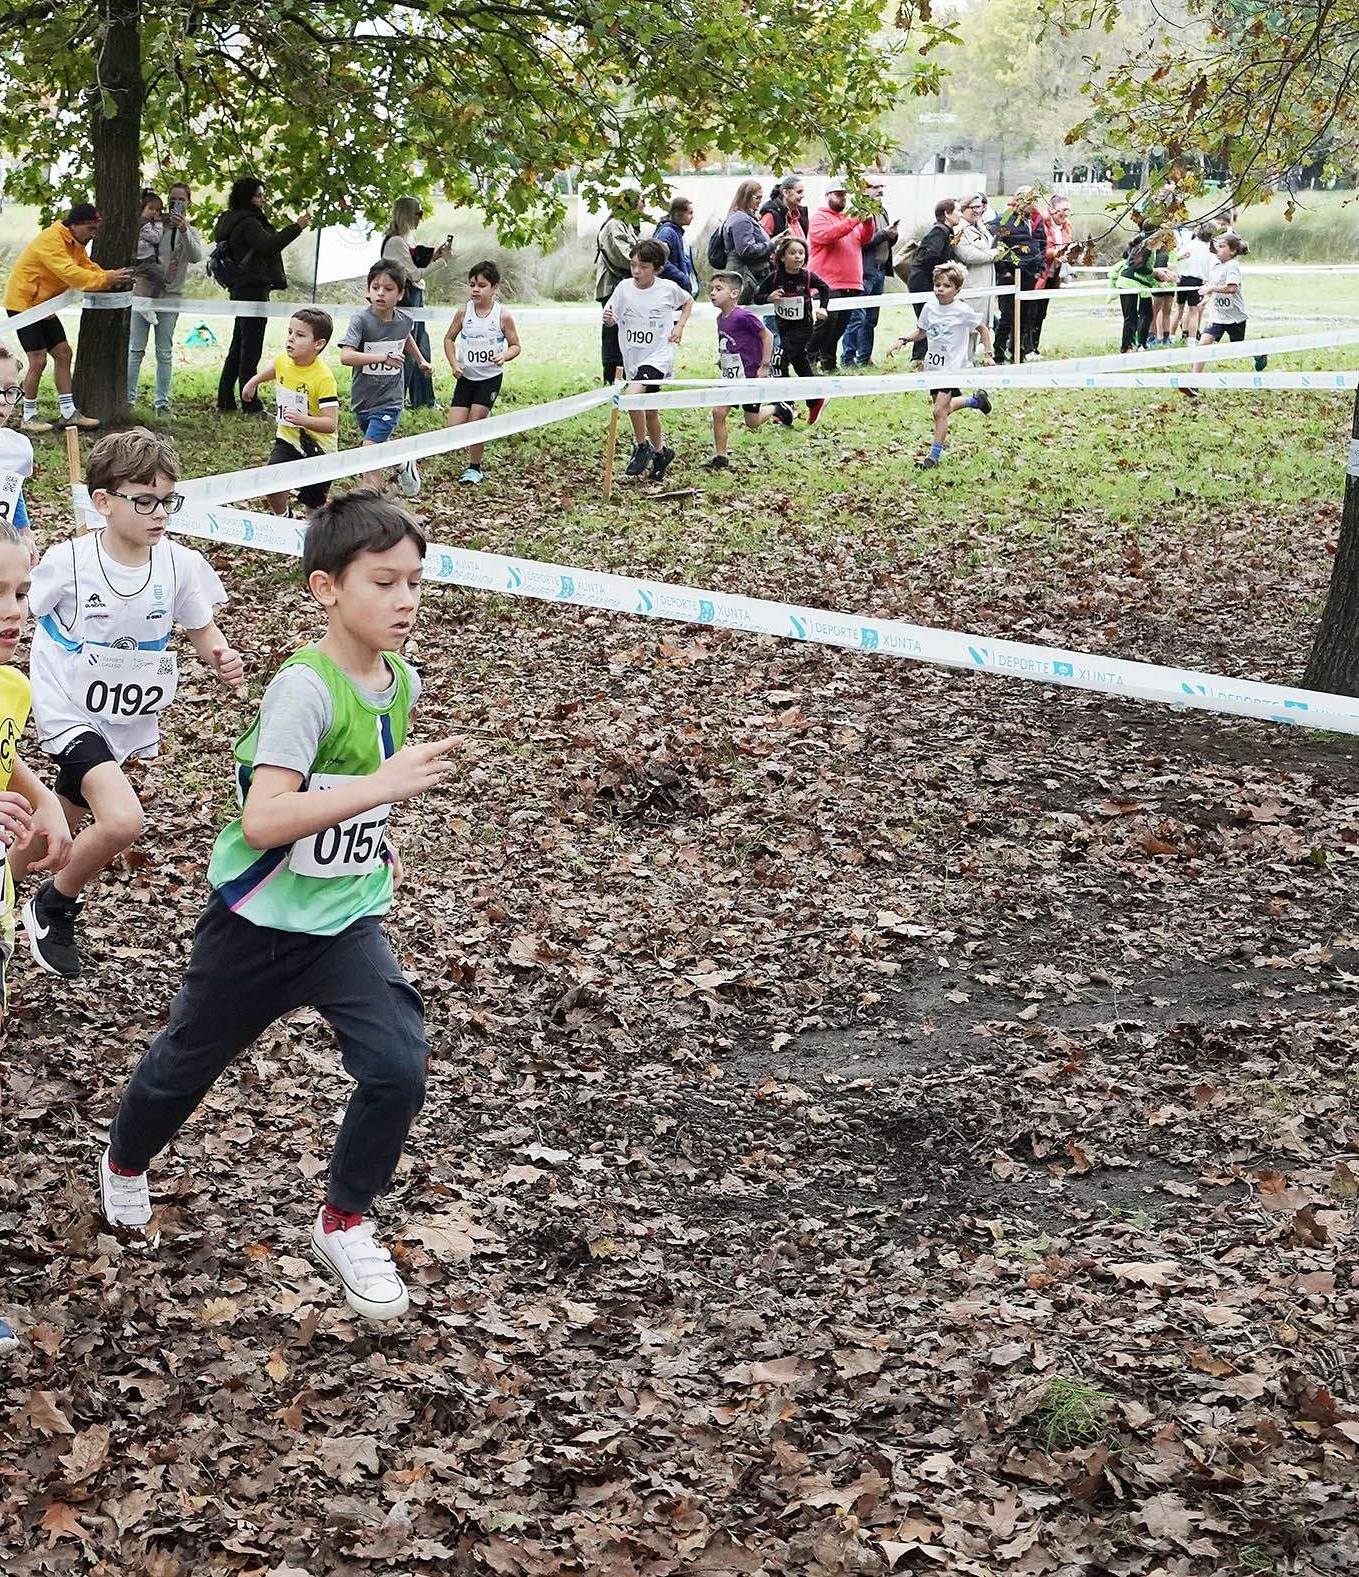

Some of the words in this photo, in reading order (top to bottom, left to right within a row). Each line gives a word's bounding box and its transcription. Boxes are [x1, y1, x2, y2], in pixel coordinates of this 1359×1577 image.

[778, 306, 799, 317] 0161
[627, 329, 653, 344] 0190
[467, 350, 494, 363] 0198
[717, 606, 752, 622] XUNTA
[815, 621, 859, 640] DEPORTE
[882, 634, 922, 652] XUNTA
[998, 653, 1050, 674] DEPORTE
[1078, 667, 1125, 686] XUNTA
[85, 680, 164, 717] 0192
